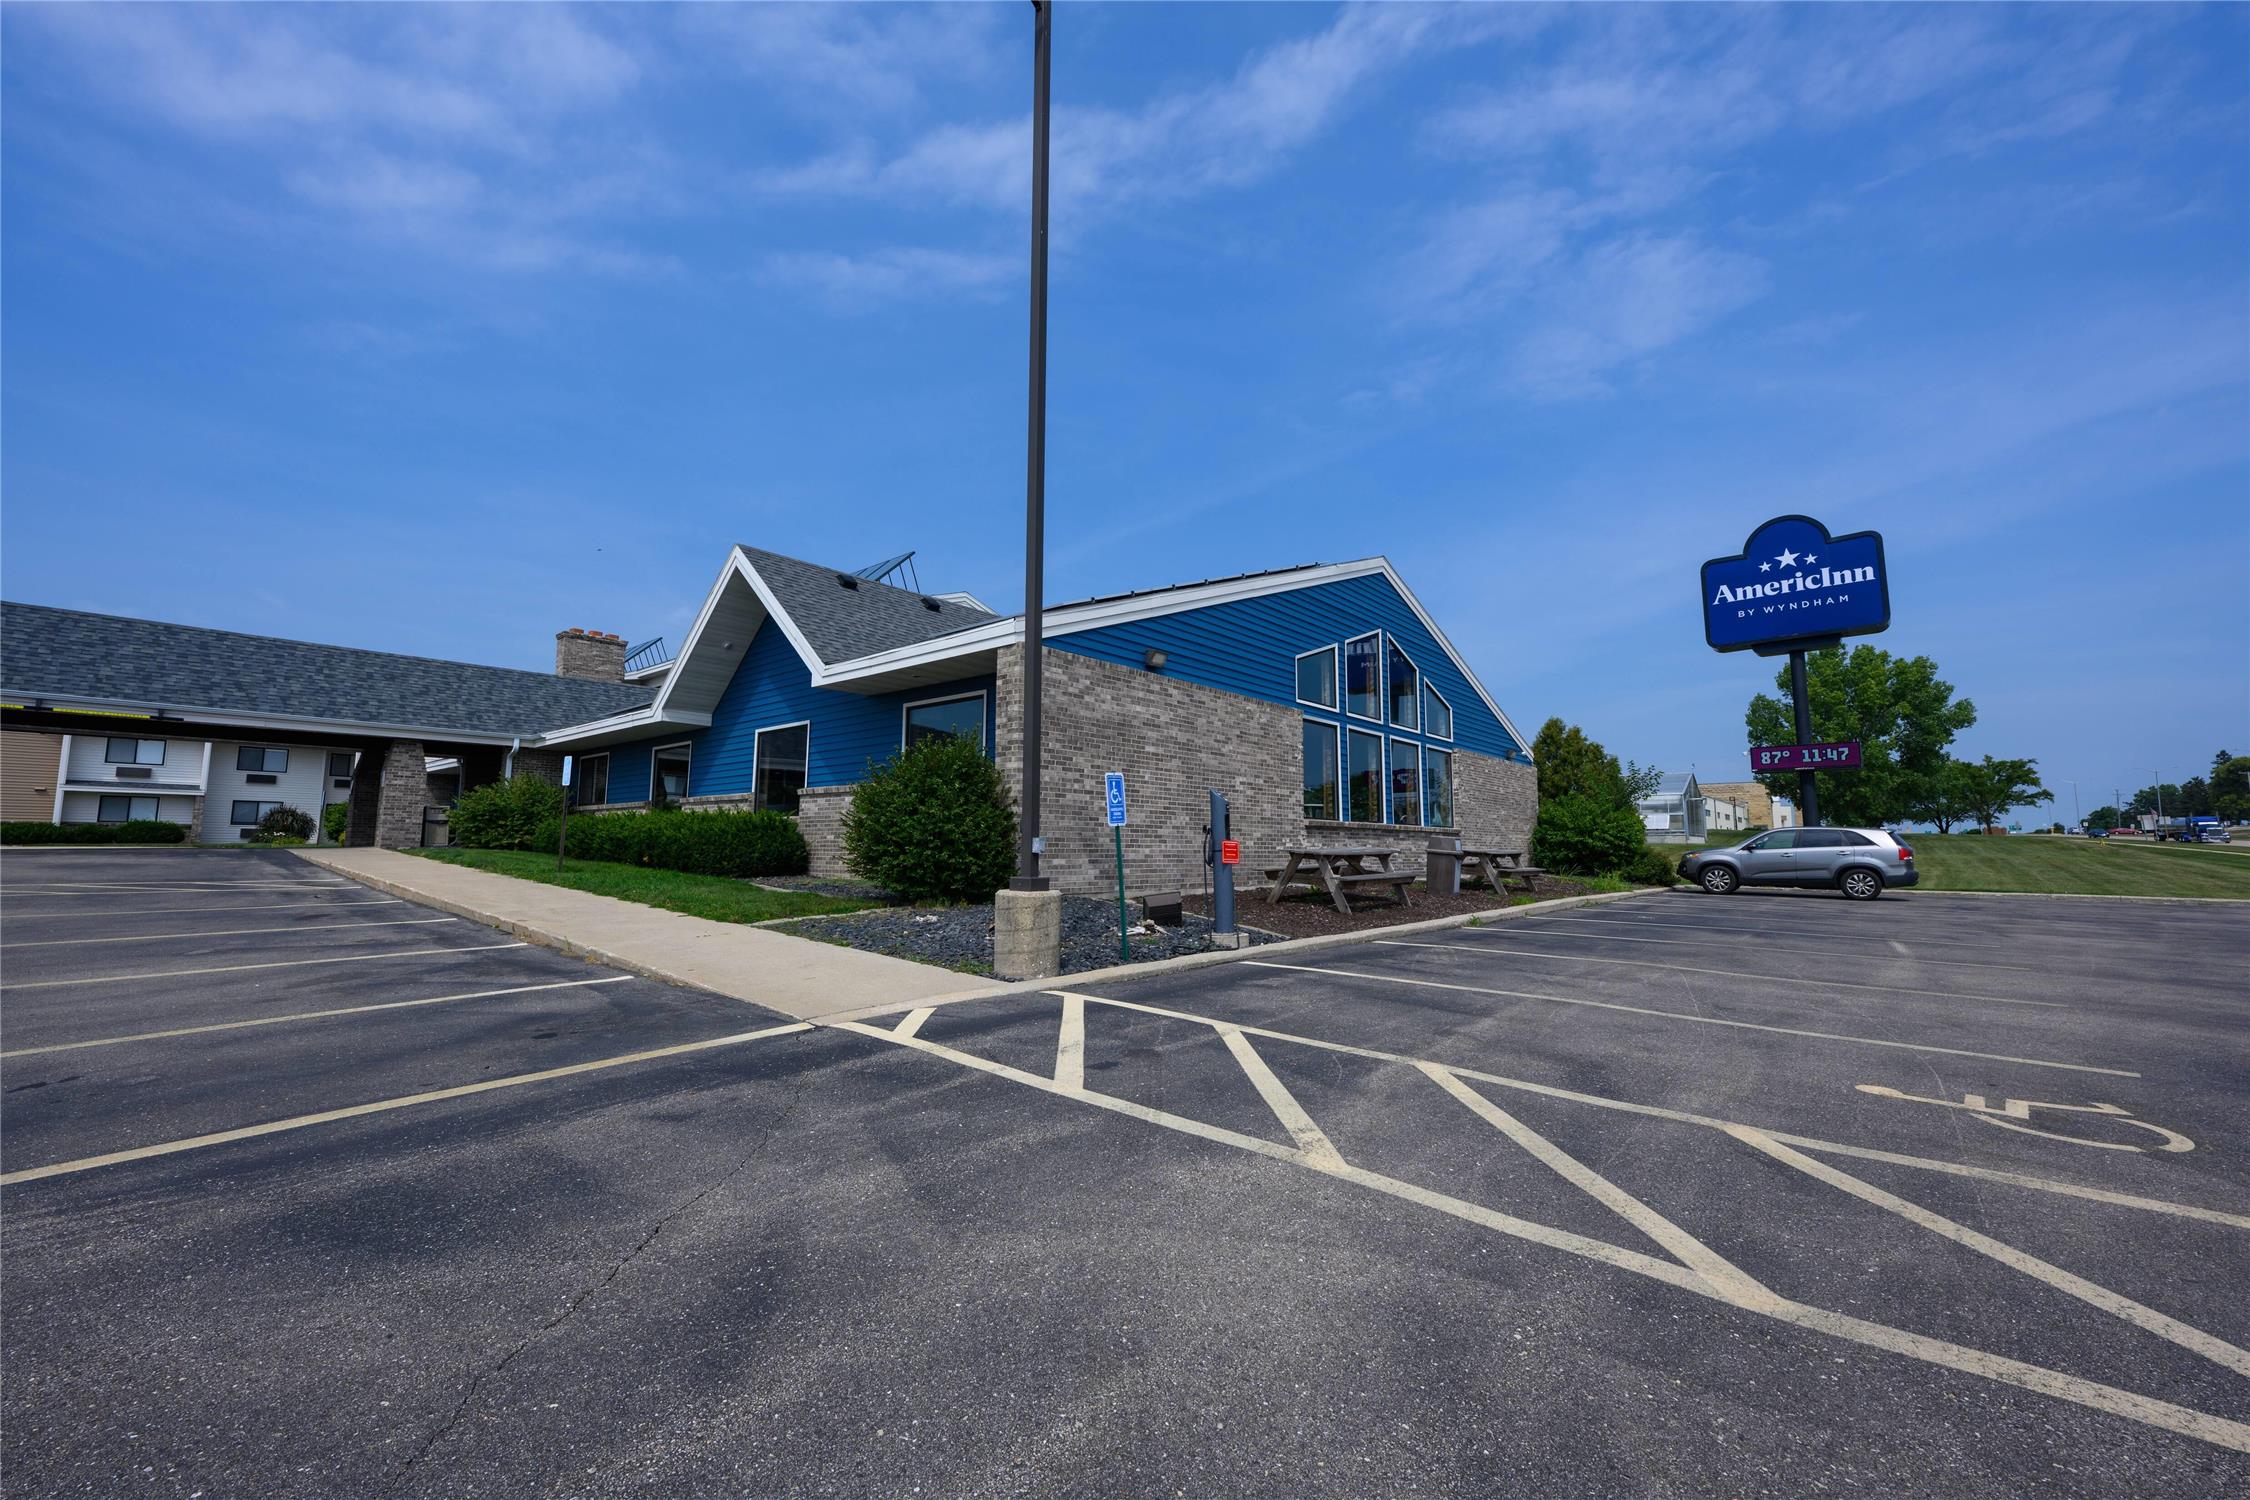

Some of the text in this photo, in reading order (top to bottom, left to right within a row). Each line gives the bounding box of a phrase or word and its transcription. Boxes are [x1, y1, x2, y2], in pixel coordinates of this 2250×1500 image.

[1712, 565, 1876, 605] AmericInn
[1738, 594, 1849, 618] BY WYNDHAM
[1760, 747, 1849, 765] 87° 11:47
